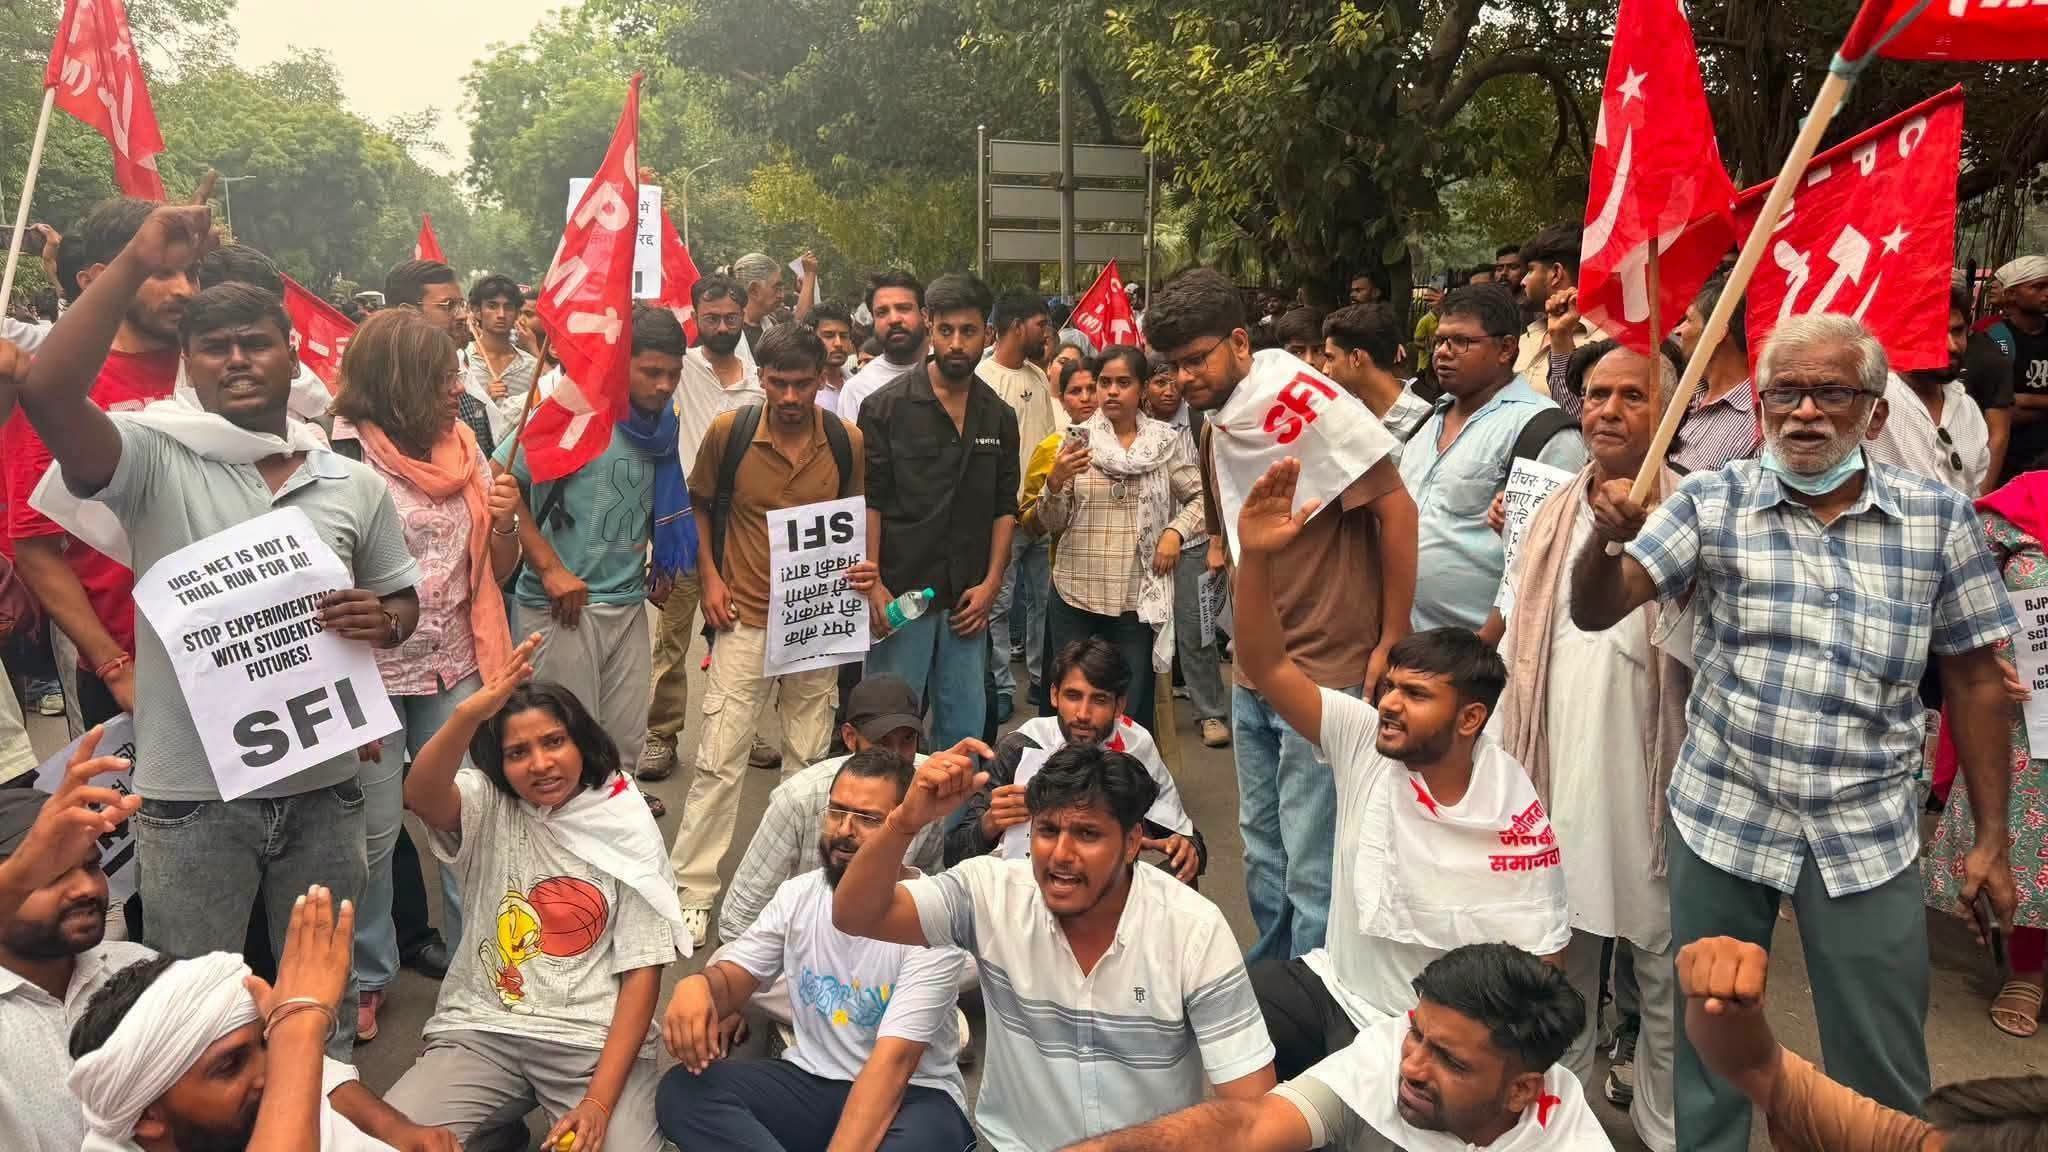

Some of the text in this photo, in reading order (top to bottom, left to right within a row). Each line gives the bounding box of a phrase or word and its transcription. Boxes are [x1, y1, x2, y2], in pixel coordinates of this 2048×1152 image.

[1263, 371, 1339, 445] SFI
[786, 511, 854, 553] SFI
[167, 534, 301, 592] UGC-NET IS NOT A
[176, 551, 313, 607] TRIAL RUN FOR AI!
[781, 601, 835, 626] सरकार,
[784, 577, 852, 608] हीं चलेगी
[838, 598, 863, 618] की
[182, 589, 336, 653] STOP EXPERIMENT
[211, 616, 323, 668] WITH STUDENTS
[783, 620, 857, 647] पेपर लीक
[245, 645, 313, 682] FUTURES!
[232, 677, 368, 768] SFI
